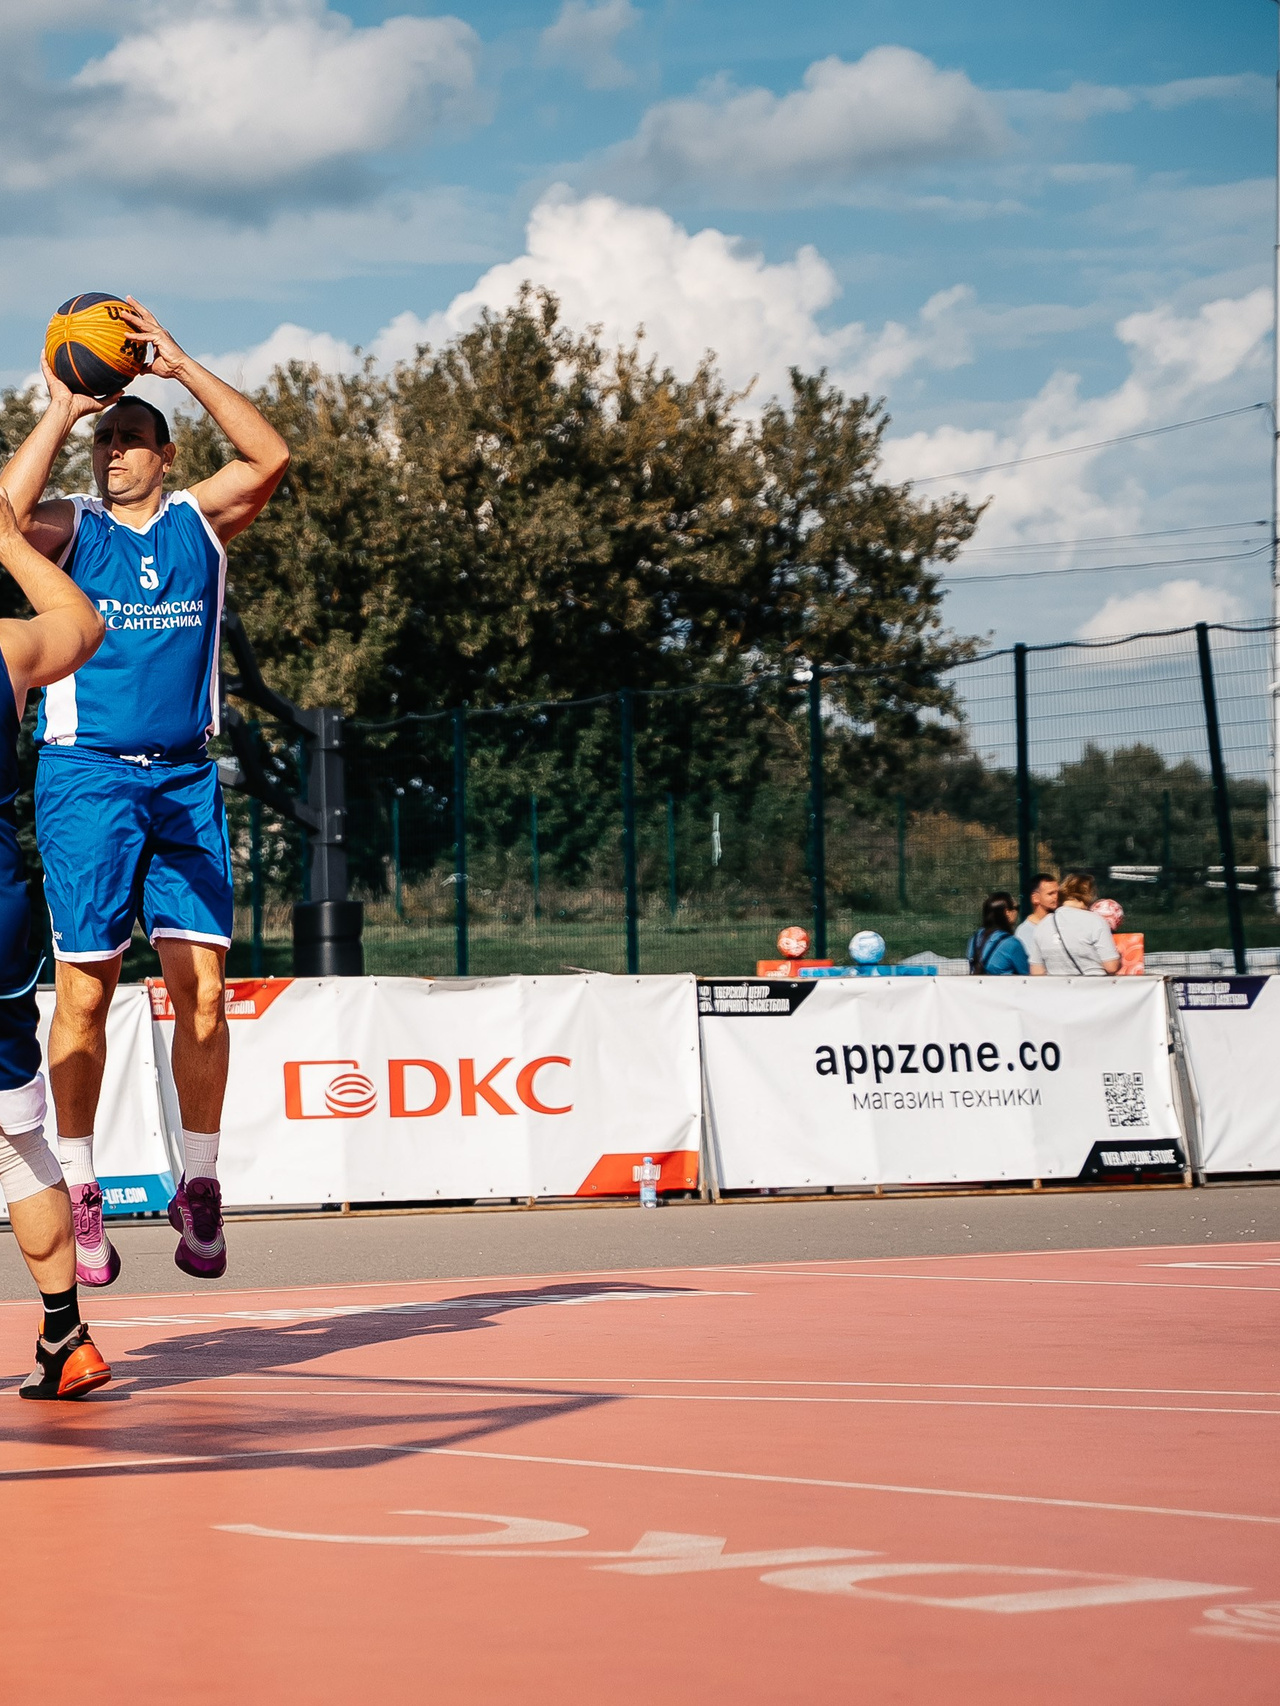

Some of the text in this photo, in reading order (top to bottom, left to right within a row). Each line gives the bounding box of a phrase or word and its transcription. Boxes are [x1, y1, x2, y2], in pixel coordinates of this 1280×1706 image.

[139, 555, 160, 591] 5
[815, 1041, 1061, 1084] appzone.co
[388, 1056, 573, 1118] DKC
[853, 1088, 1043, 1110] магазин техники
[103, 1187, 148, 1204] -LIFE.COM
